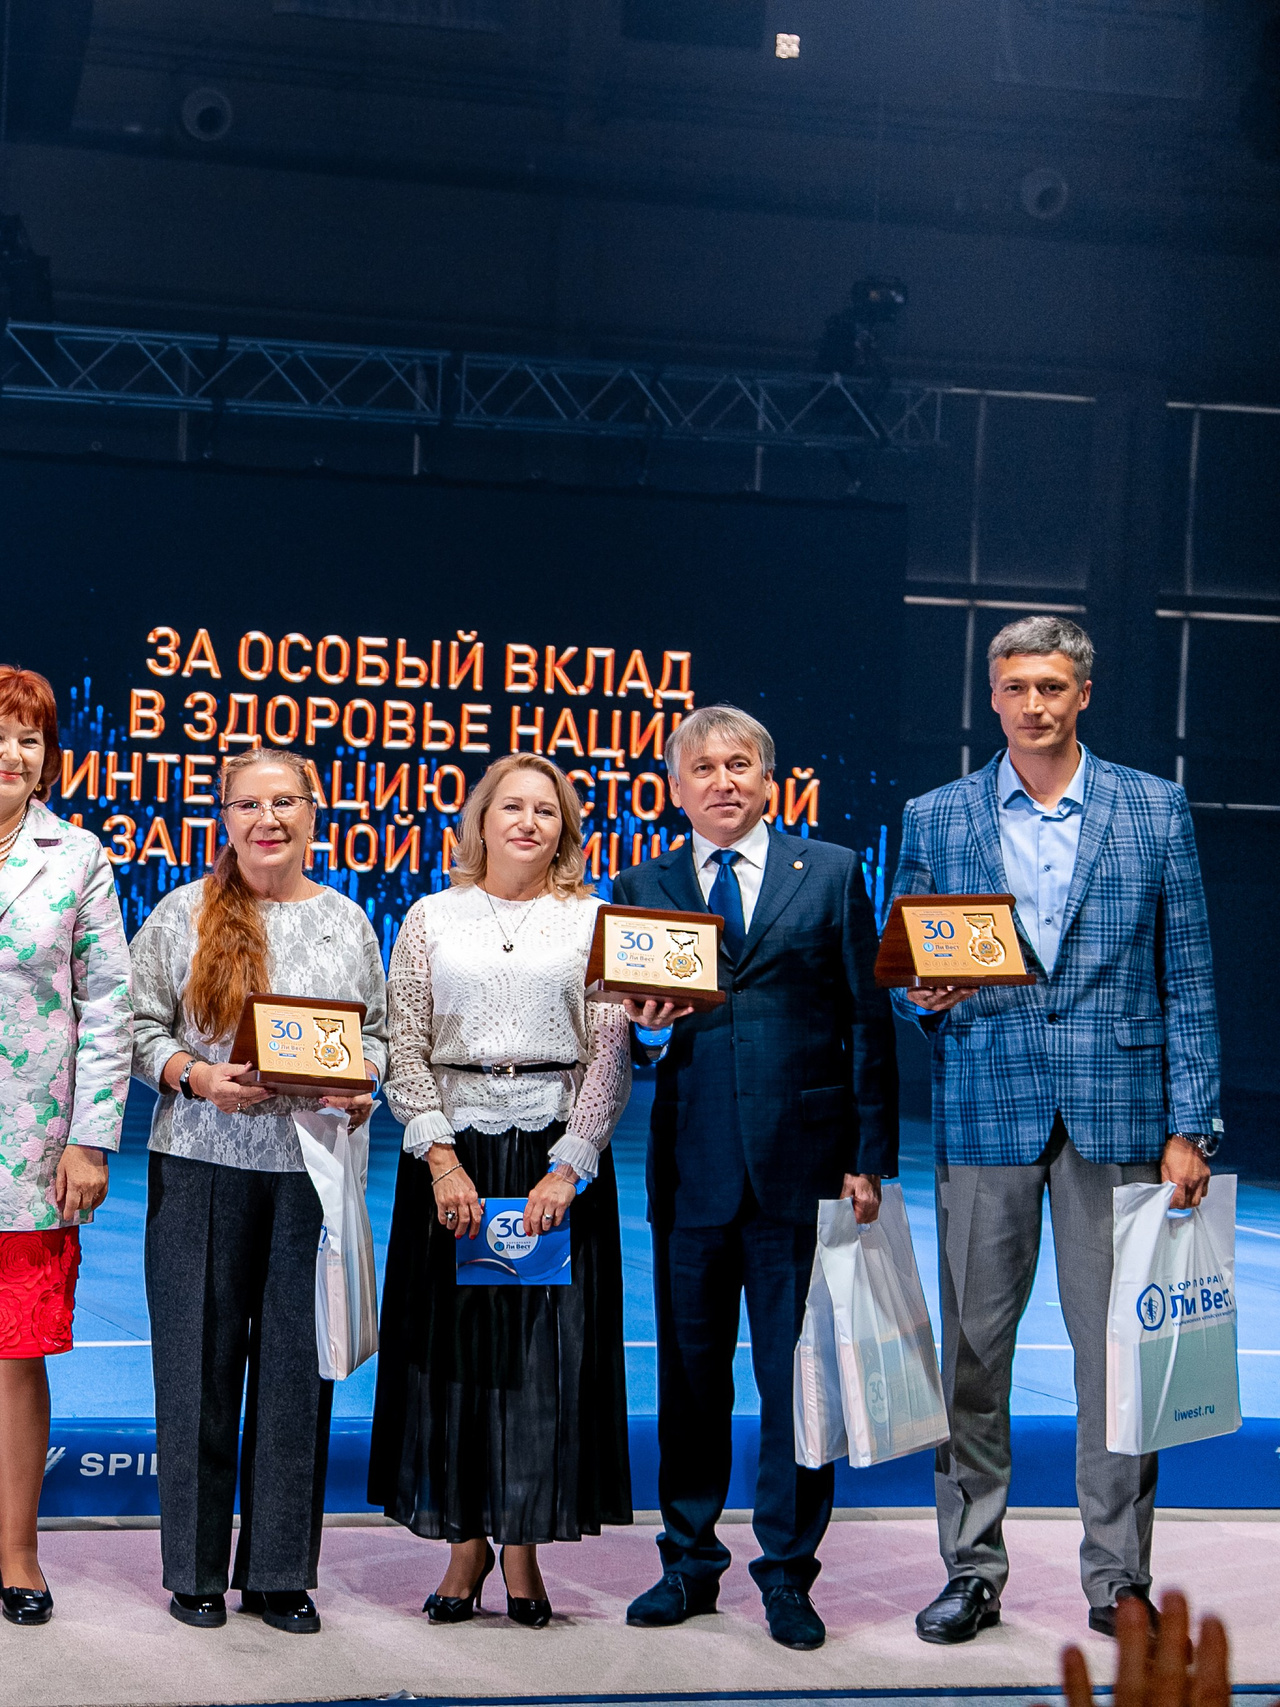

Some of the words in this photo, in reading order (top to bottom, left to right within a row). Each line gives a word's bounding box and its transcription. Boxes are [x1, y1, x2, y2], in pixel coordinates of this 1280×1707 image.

[146, 626, 222, 680] ЗА
[238, 629, 485, 691] ОСОБЫЙ
[504, 643, 695, 711] ВКЛАД
[129, 688, 166, 739] В
[184, 691, 492, 754] ЗДОРОВЬЕ
[61, 749, 466, 820] ИНТЕАЦИЮ
[103, 813, 421, 874] ЗАПНОЙ
[620, 930, 654, 951] 30
[921, 920, 955, 939] 30
[271, 1019, 302, 1040] 30
[1170, 1295, 1196, 1319] Ли
[1174, 1404, 1215, 1421] liwest.ru
